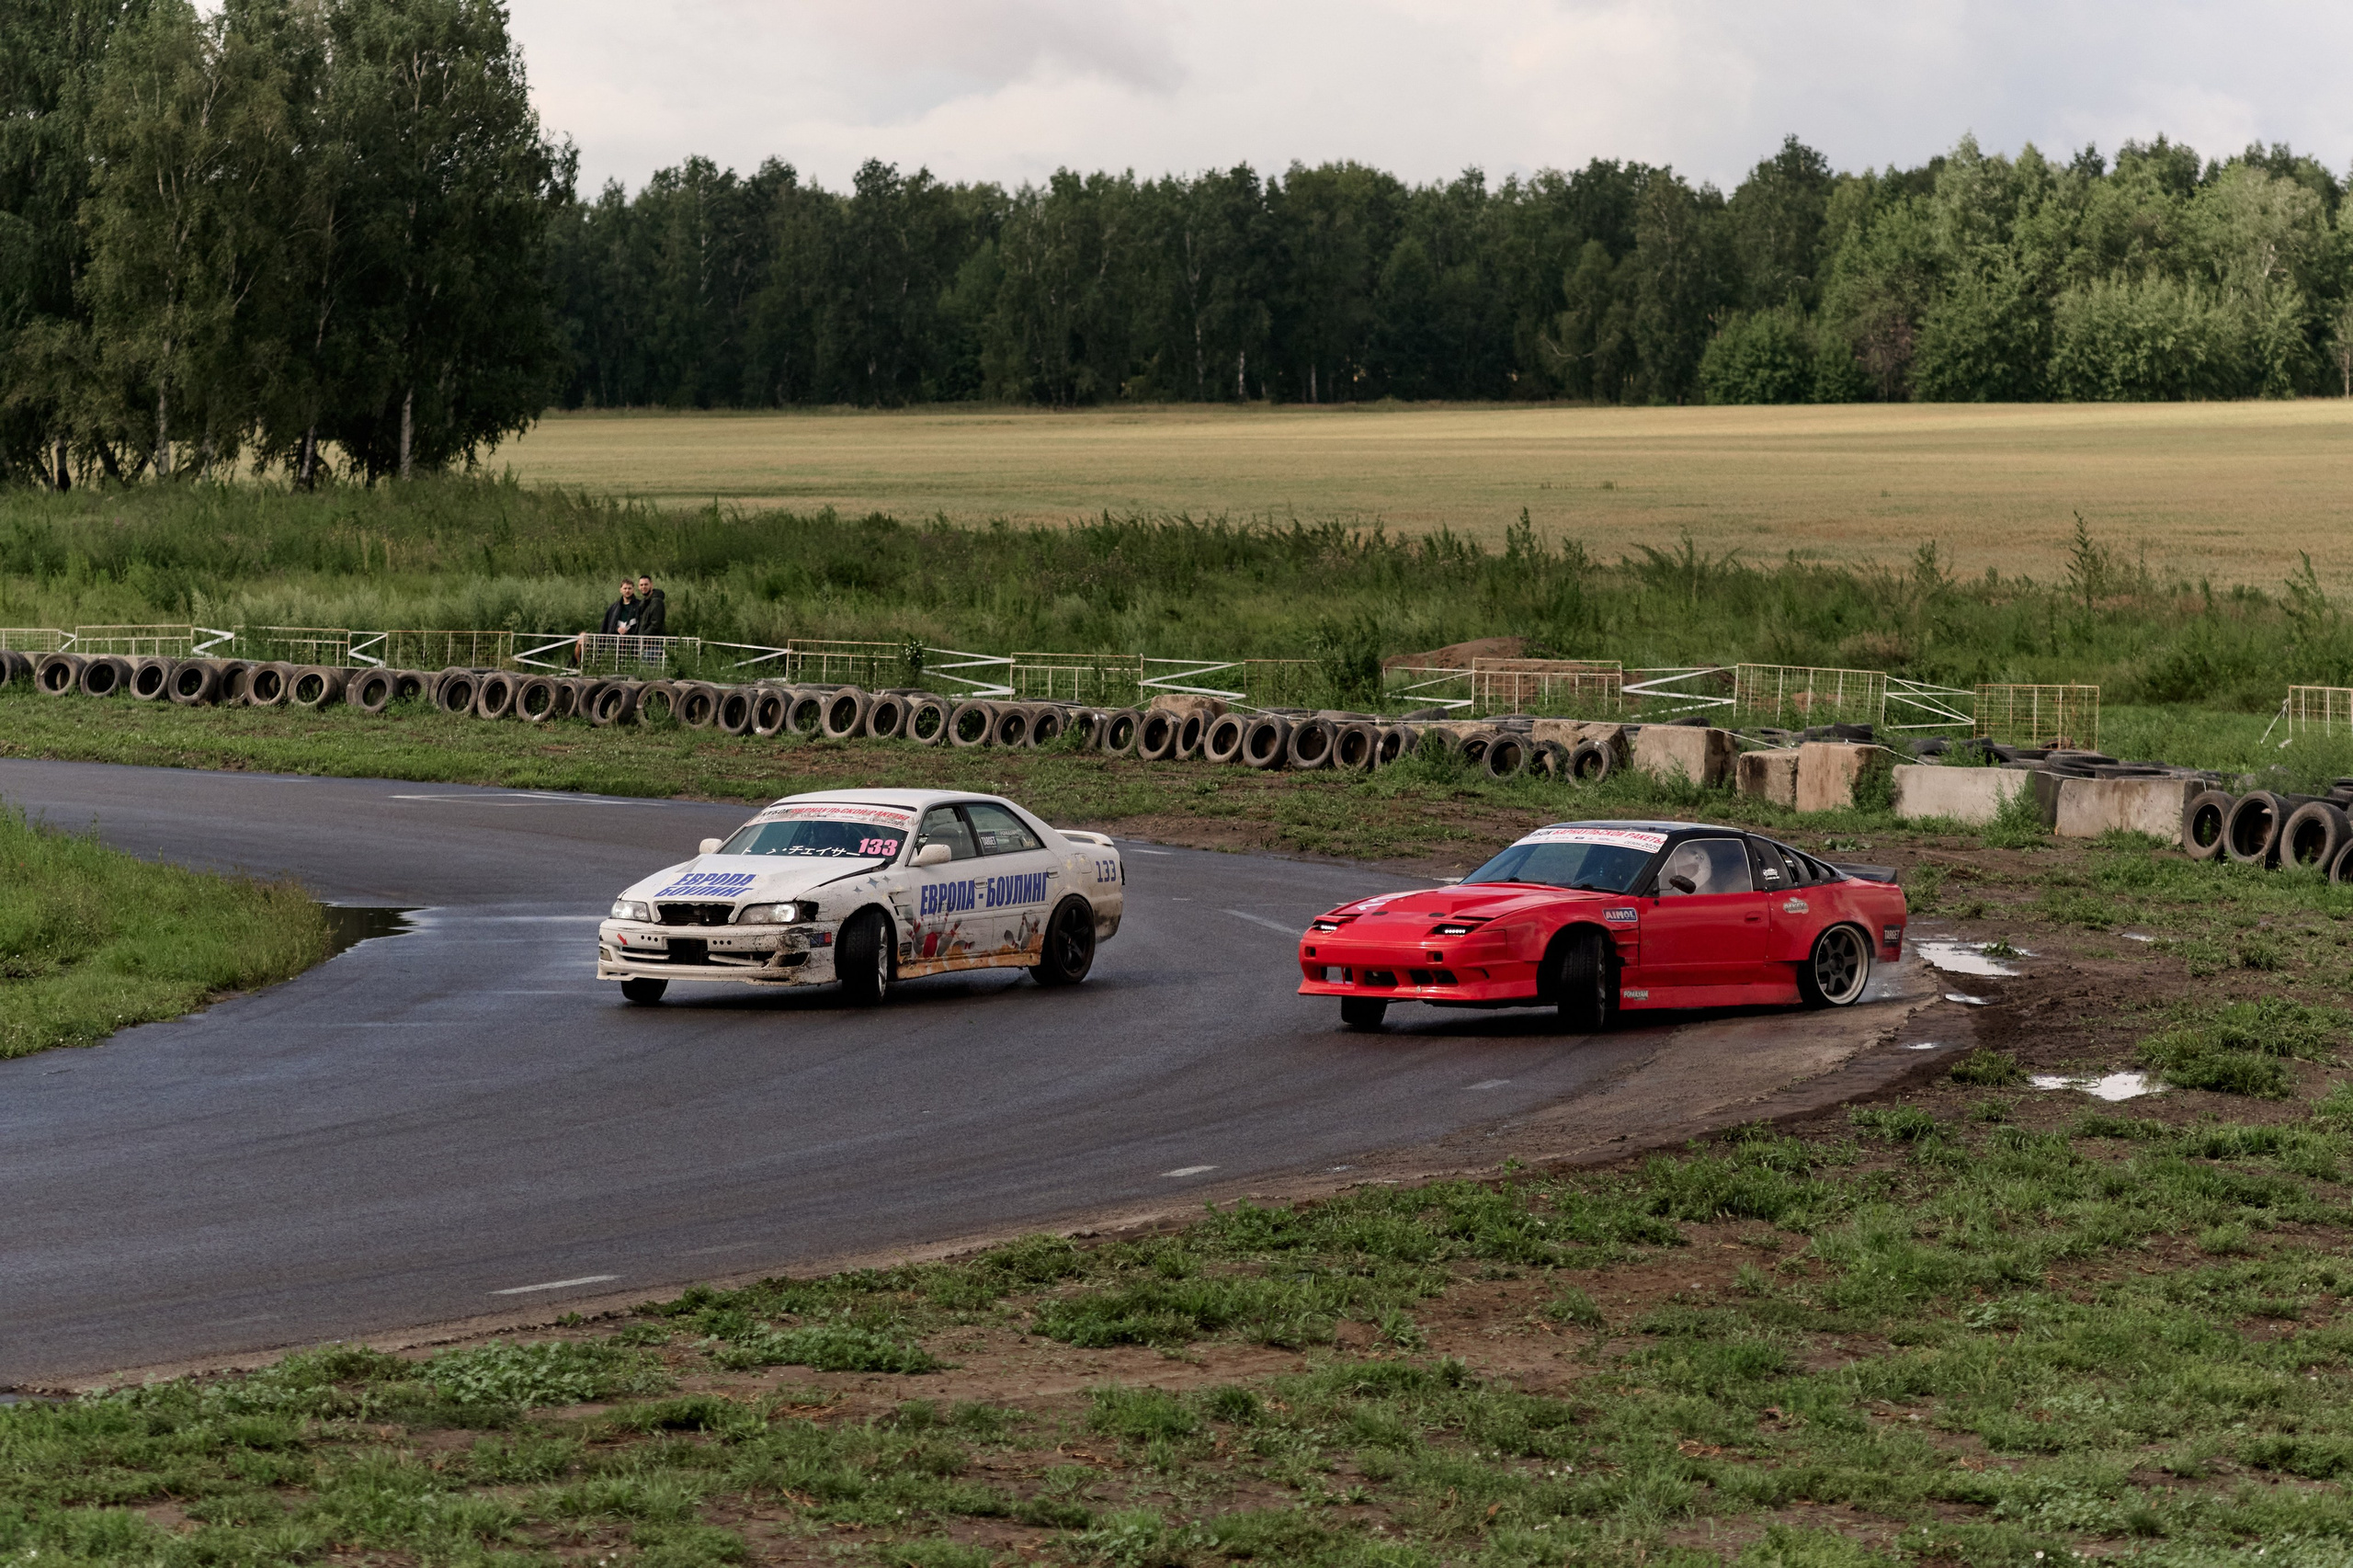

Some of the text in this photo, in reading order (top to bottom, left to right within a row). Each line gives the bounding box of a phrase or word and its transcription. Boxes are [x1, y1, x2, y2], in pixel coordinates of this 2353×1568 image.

[1552, 829, 1626, 837] БАРНАУЛЬСКОЙ
[858, 837, 898, 857] 133
[1096, 860, 1117, 882] 133
[673, 873, 757, 886] ЕВРОПА
[654, 886, 755, 897] БОУЛИНГ
